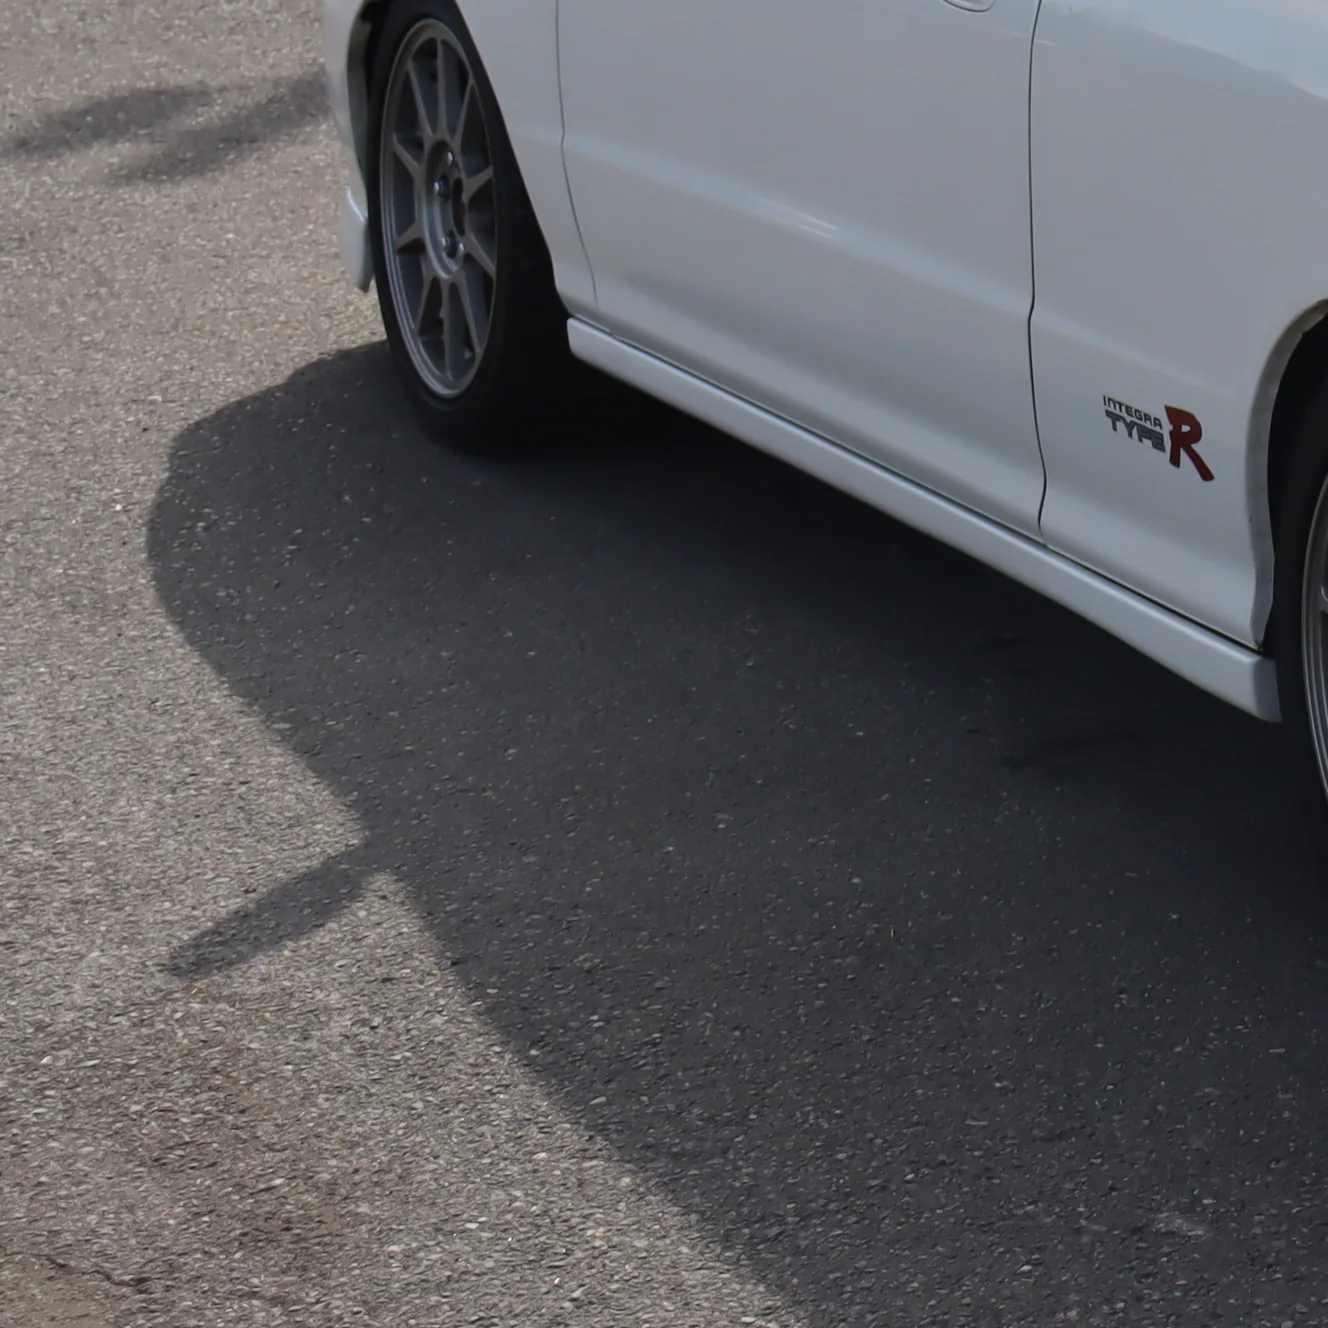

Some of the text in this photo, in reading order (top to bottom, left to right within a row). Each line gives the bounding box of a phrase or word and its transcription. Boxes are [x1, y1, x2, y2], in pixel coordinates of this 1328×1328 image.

[1102, 394, 1164, 431] INTEGRA
[1104, 403, 1216, 483] TYPE R
